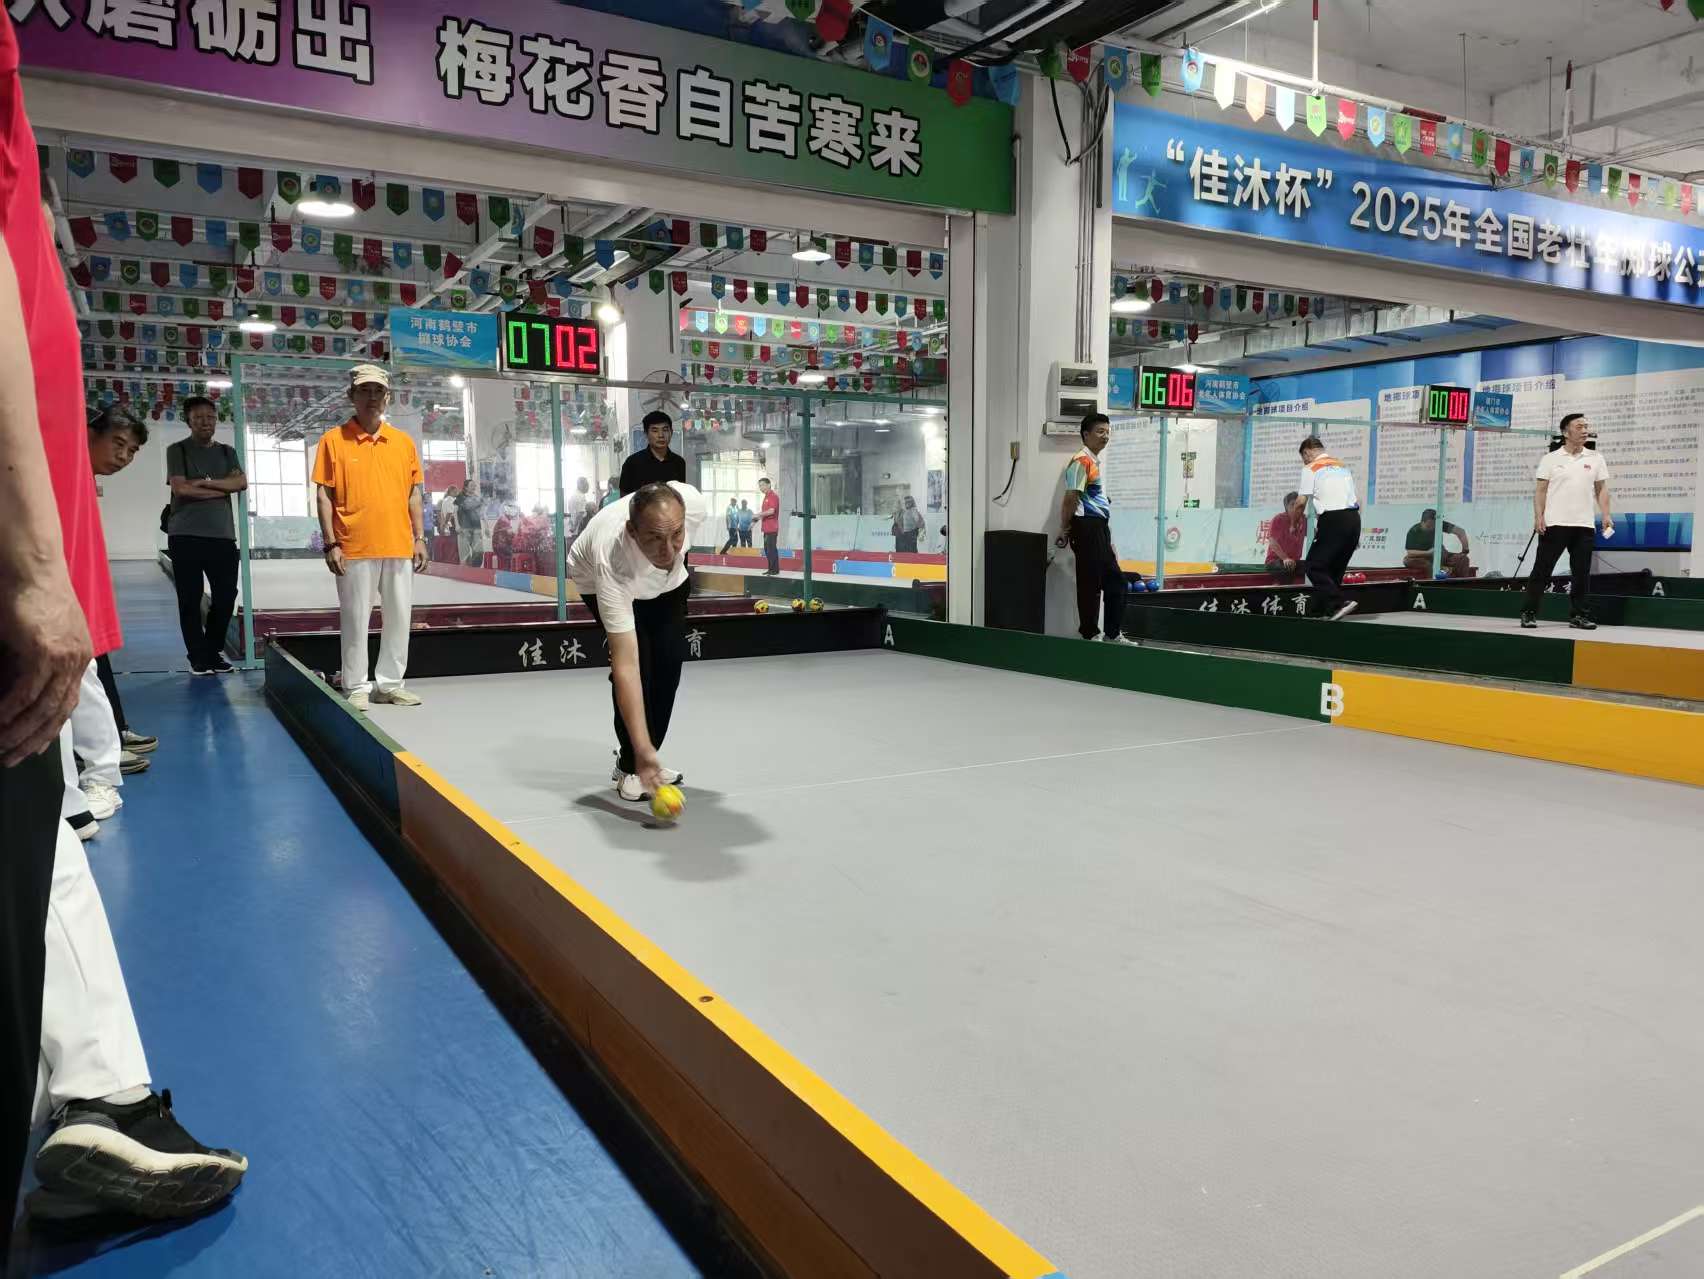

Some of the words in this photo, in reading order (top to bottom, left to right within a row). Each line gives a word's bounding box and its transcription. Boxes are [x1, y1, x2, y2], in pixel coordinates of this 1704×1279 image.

[436, 16, 922, 177] 梅花香自苦寒来
[508, 320, 551, 366] 07
[555, 324, 597, 370] 02
[1141, 372, 1167, 405] 06
[1168, 373, 1194, 407] 06
[1429, 390, 1448, 419] 00
[1449, 391, 1469, 420] 00
[1413, 592, 1427, 610] A
[1651, 580, 1665, 597] A
[518, 628, 708, 668] 佳沐育
[883, 623, 896, 648] A
[1320, 682, 1345, 717] B
